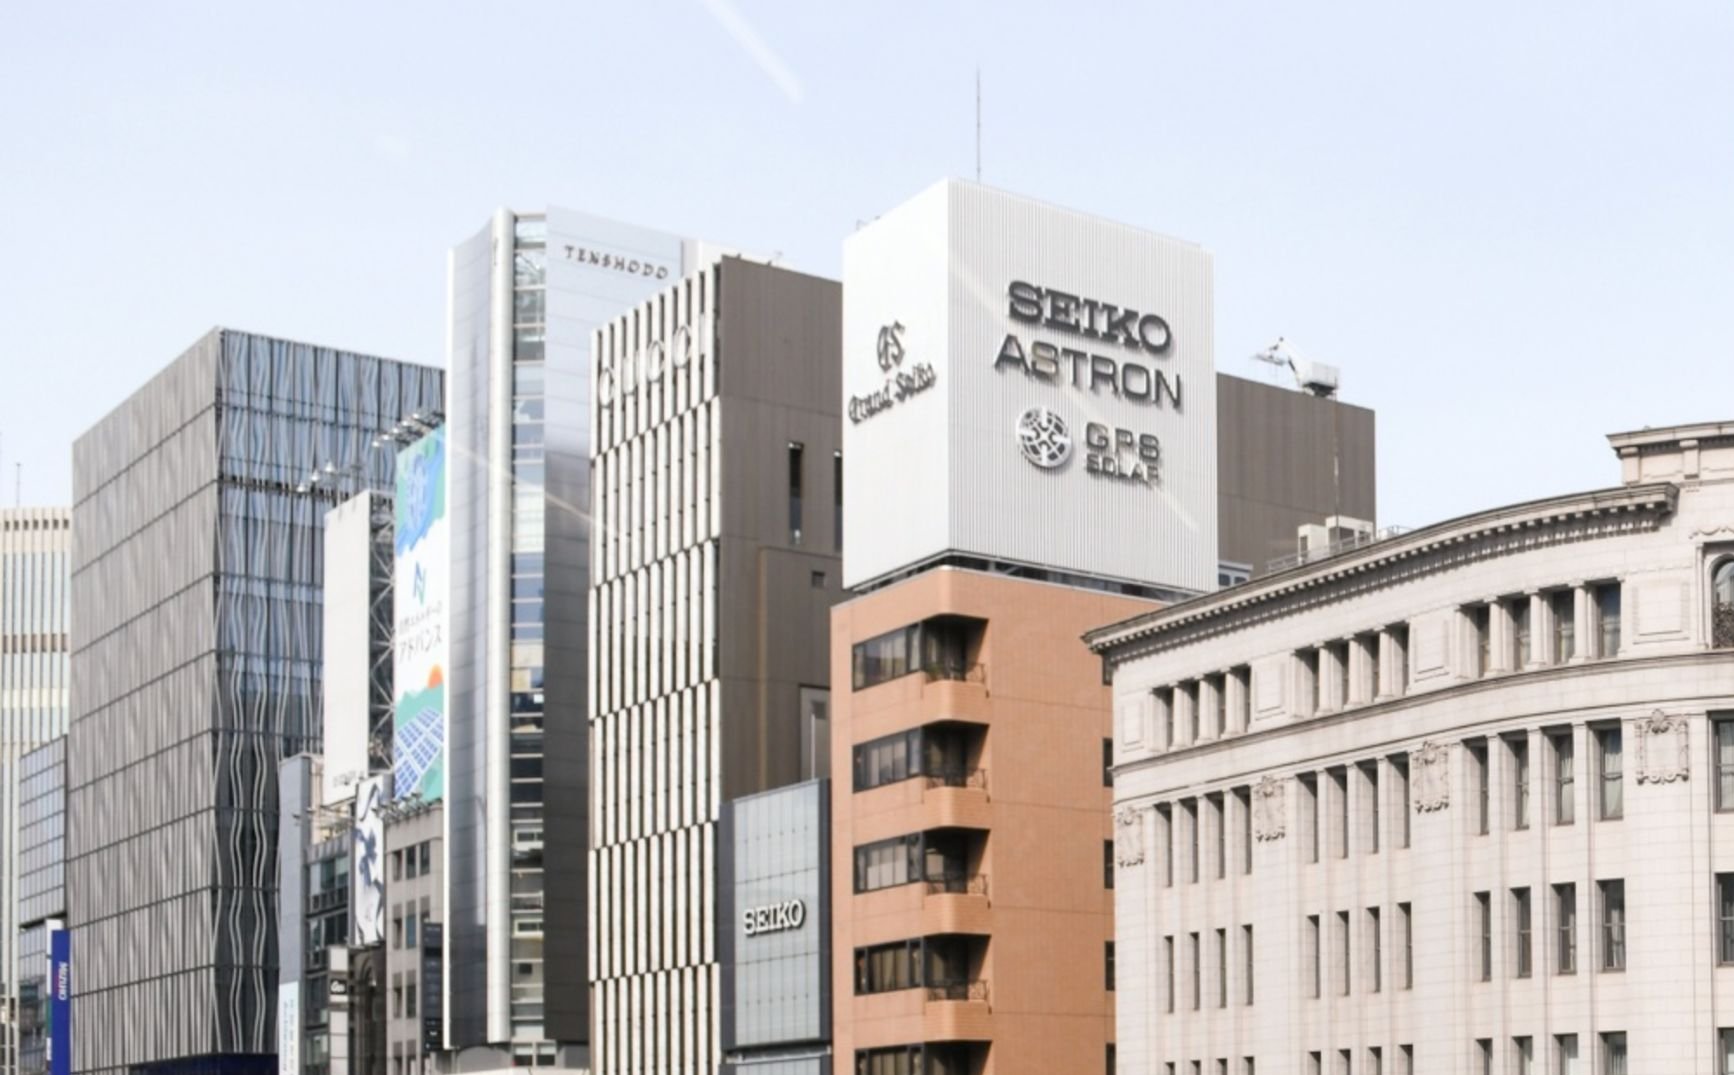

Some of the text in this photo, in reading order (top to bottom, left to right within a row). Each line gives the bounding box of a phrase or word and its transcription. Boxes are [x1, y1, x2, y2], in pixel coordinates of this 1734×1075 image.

[564, 244, 668, 280] TENSHODO
[1009, 280, 1172, 355] SEIKO
[848, 361, 937, 426] Grand Seiko
[994, 333, 1183, 412] ASTRON
[1086, 421, 1160, 463] GPS
[743, 899, 806, 938] SEIKO
